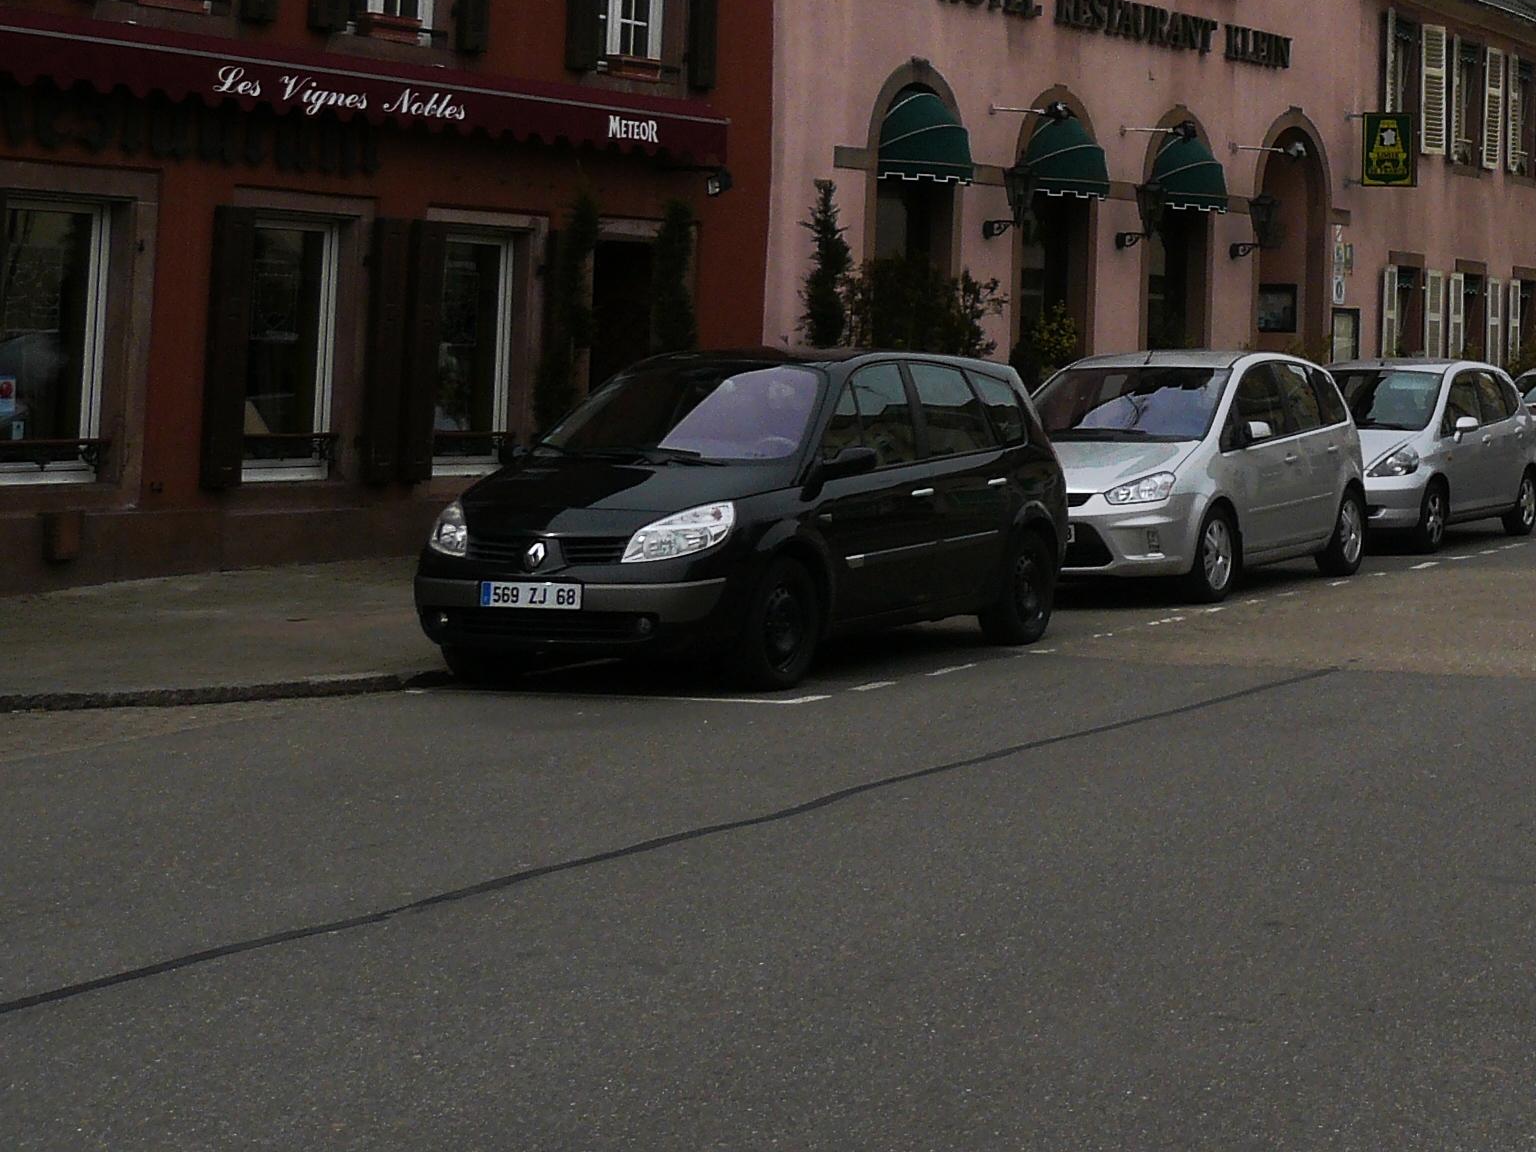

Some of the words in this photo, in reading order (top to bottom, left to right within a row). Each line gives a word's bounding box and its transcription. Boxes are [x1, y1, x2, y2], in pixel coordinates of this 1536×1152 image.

[1225, 23, 1293, 70] KLEIN
[213, 65, 261, 97] Les
[279, 73, 368, 116] Vignes
[382, 88, 466, 120] Nobles
[608, 114, 660, 144] METEOR
[493, 586, 519, 604] 569
[528, 587, 547, 604] ZJ
[556, 588, 576, 605] 68
